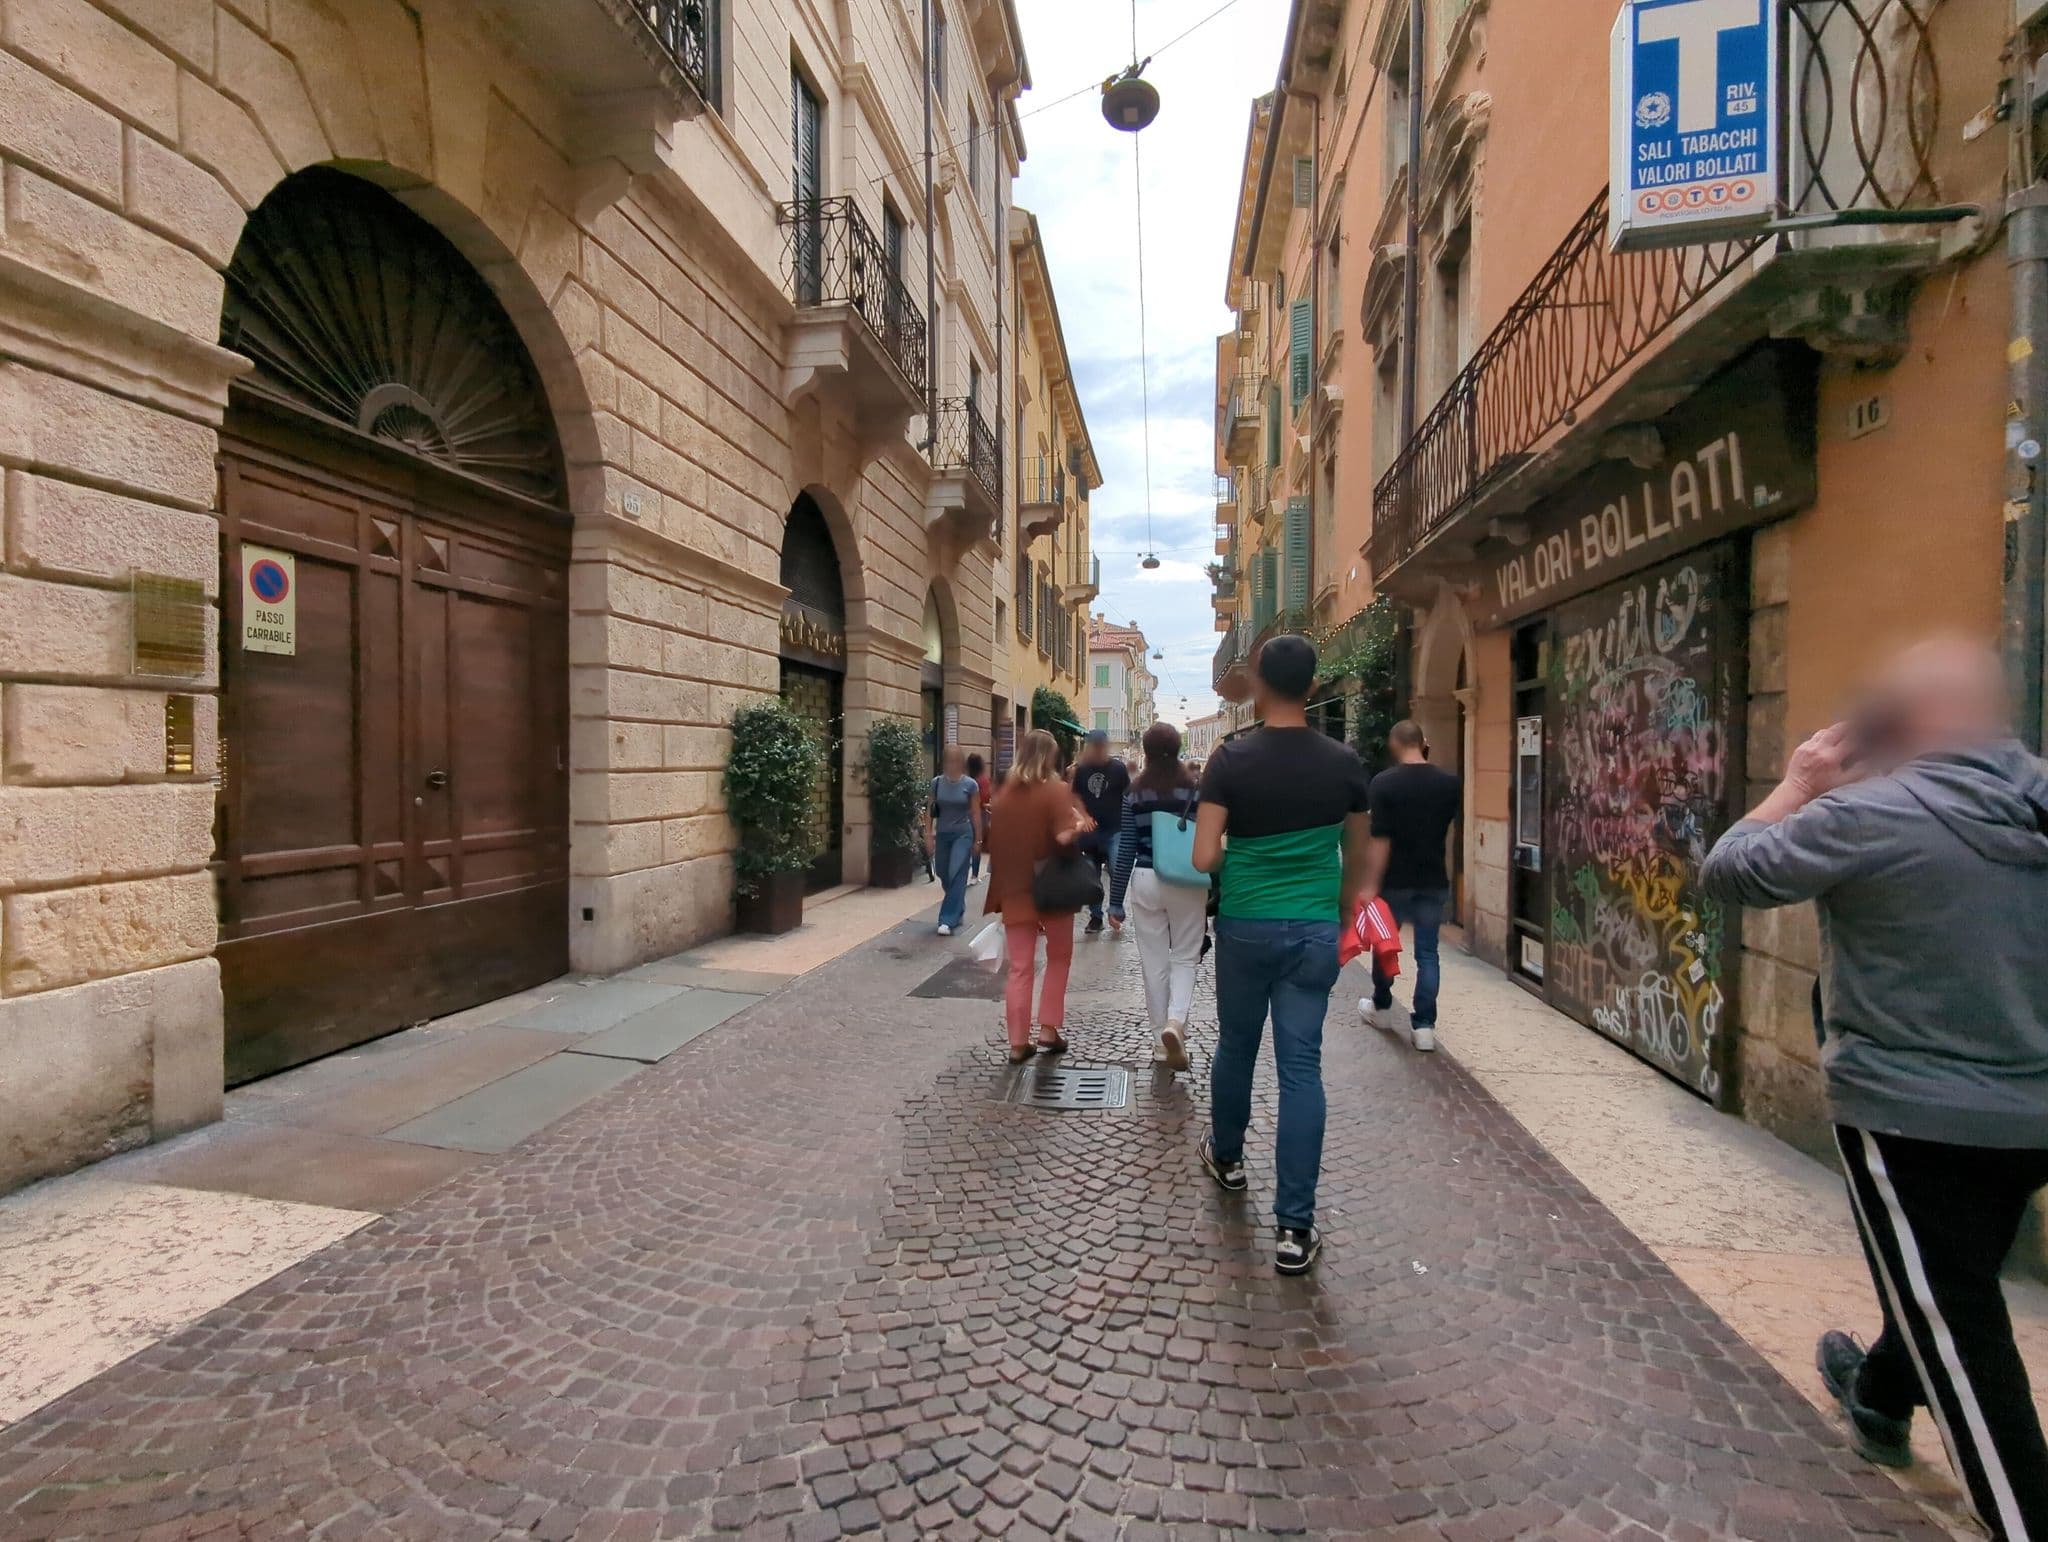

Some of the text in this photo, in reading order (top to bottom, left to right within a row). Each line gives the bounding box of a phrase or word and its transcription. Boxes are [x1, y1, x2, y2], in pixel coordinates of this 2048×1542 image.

[1638, 0, 1760, 133] T
[1727, 82, 1757, 100] RIV.
[1638, 128, 1757, 161] SALI TABACCHI
[1638, 152, 1757, 185] VALORI BOLLATI
[255, 609, 284, 625] PASSO
[246, 626, 292, 644] CARRABILE
